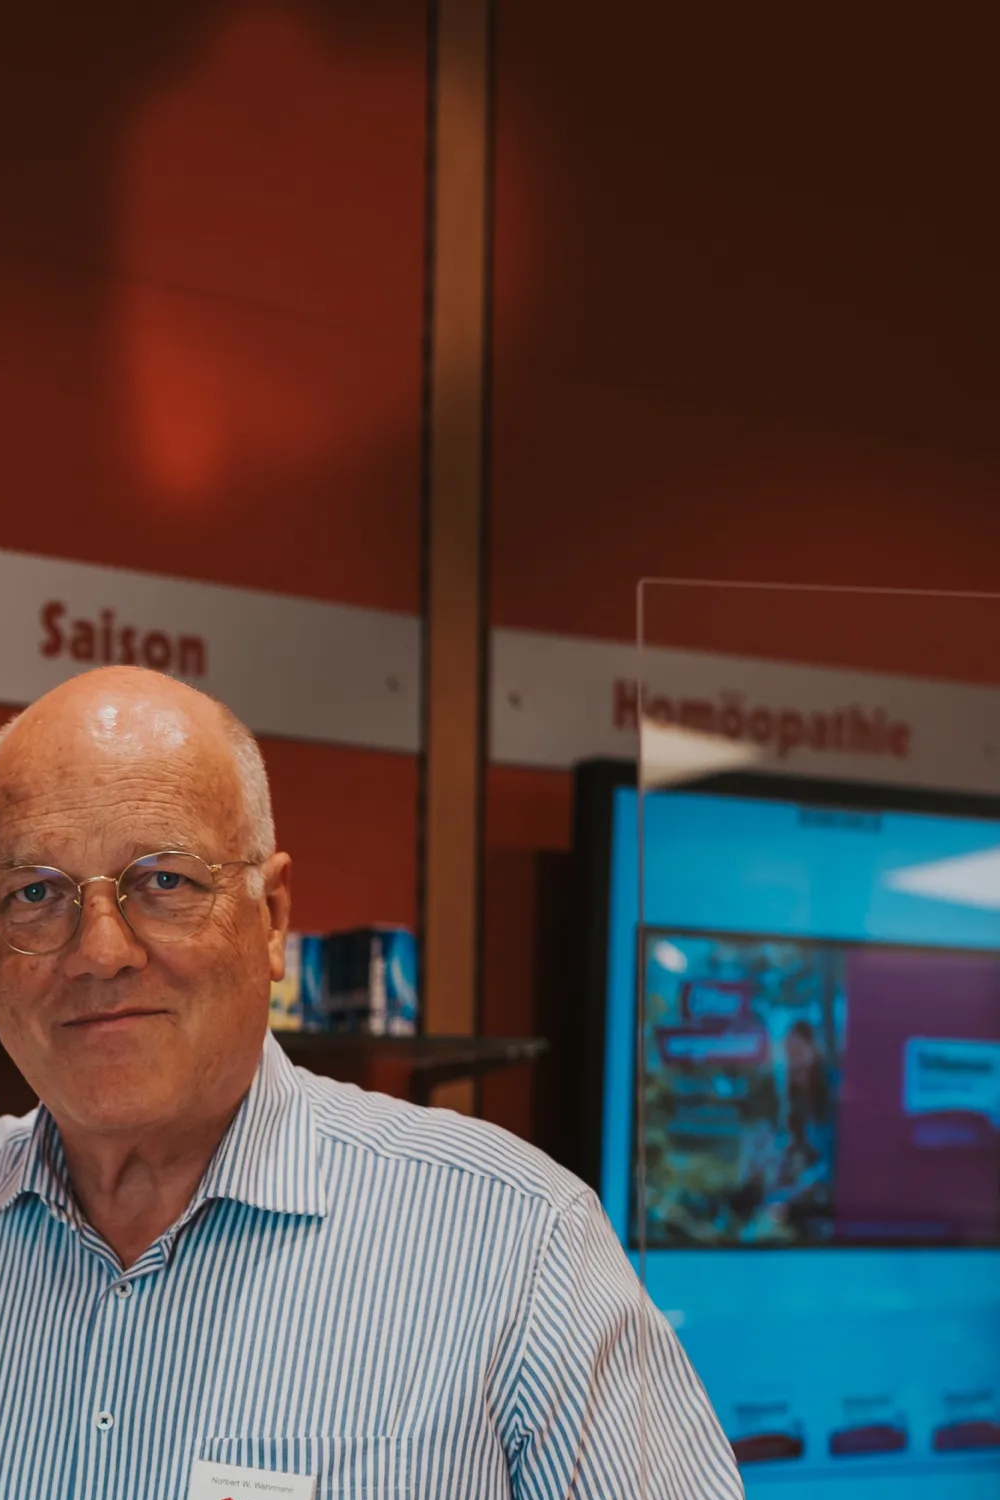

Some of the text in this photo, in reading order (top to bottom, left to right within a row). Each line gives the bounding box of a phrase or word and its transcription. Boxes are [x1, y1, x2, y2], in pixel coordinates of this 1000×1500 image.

[39, 600, 208, 676] Saison
[212, 1476, 295, 1494] Norbert W. Wehrmann
